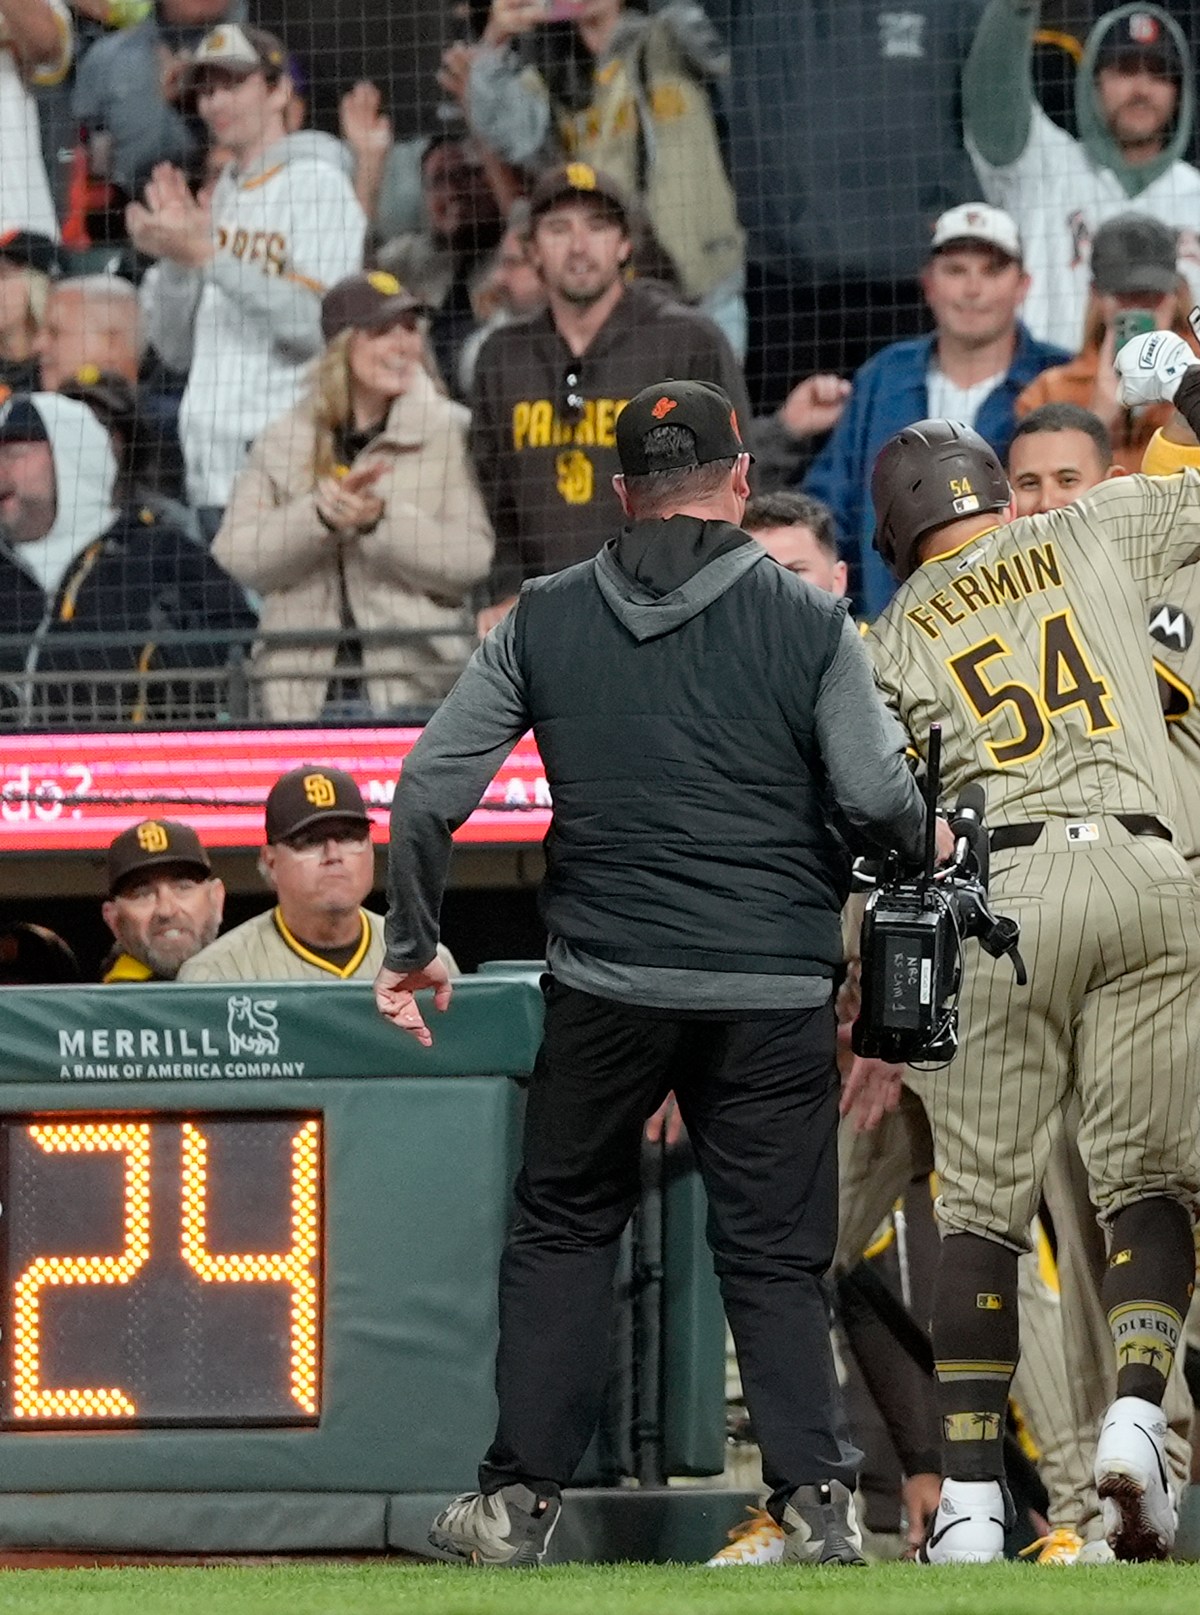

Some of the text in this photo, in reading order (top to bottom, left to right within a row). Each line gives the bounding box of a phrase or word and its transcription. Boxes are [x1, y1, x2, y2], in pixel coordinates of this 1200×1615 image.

[949, 476, 974, 498] 54
[905, 541, 1064, 640] FERMIN
[944, 608, 1121, 769] 54
[303, 773, 336, 807] SD
[137, 821, 168, 852] SD
[58, 1029, 219, 1057] MERRILL
[60, 1062, 305, 1079] A BANK OF AMERICA COMPANY
[14, 1120, 318, 1418] 24
[1117, 1317, 1178, 1343] DIEGO
